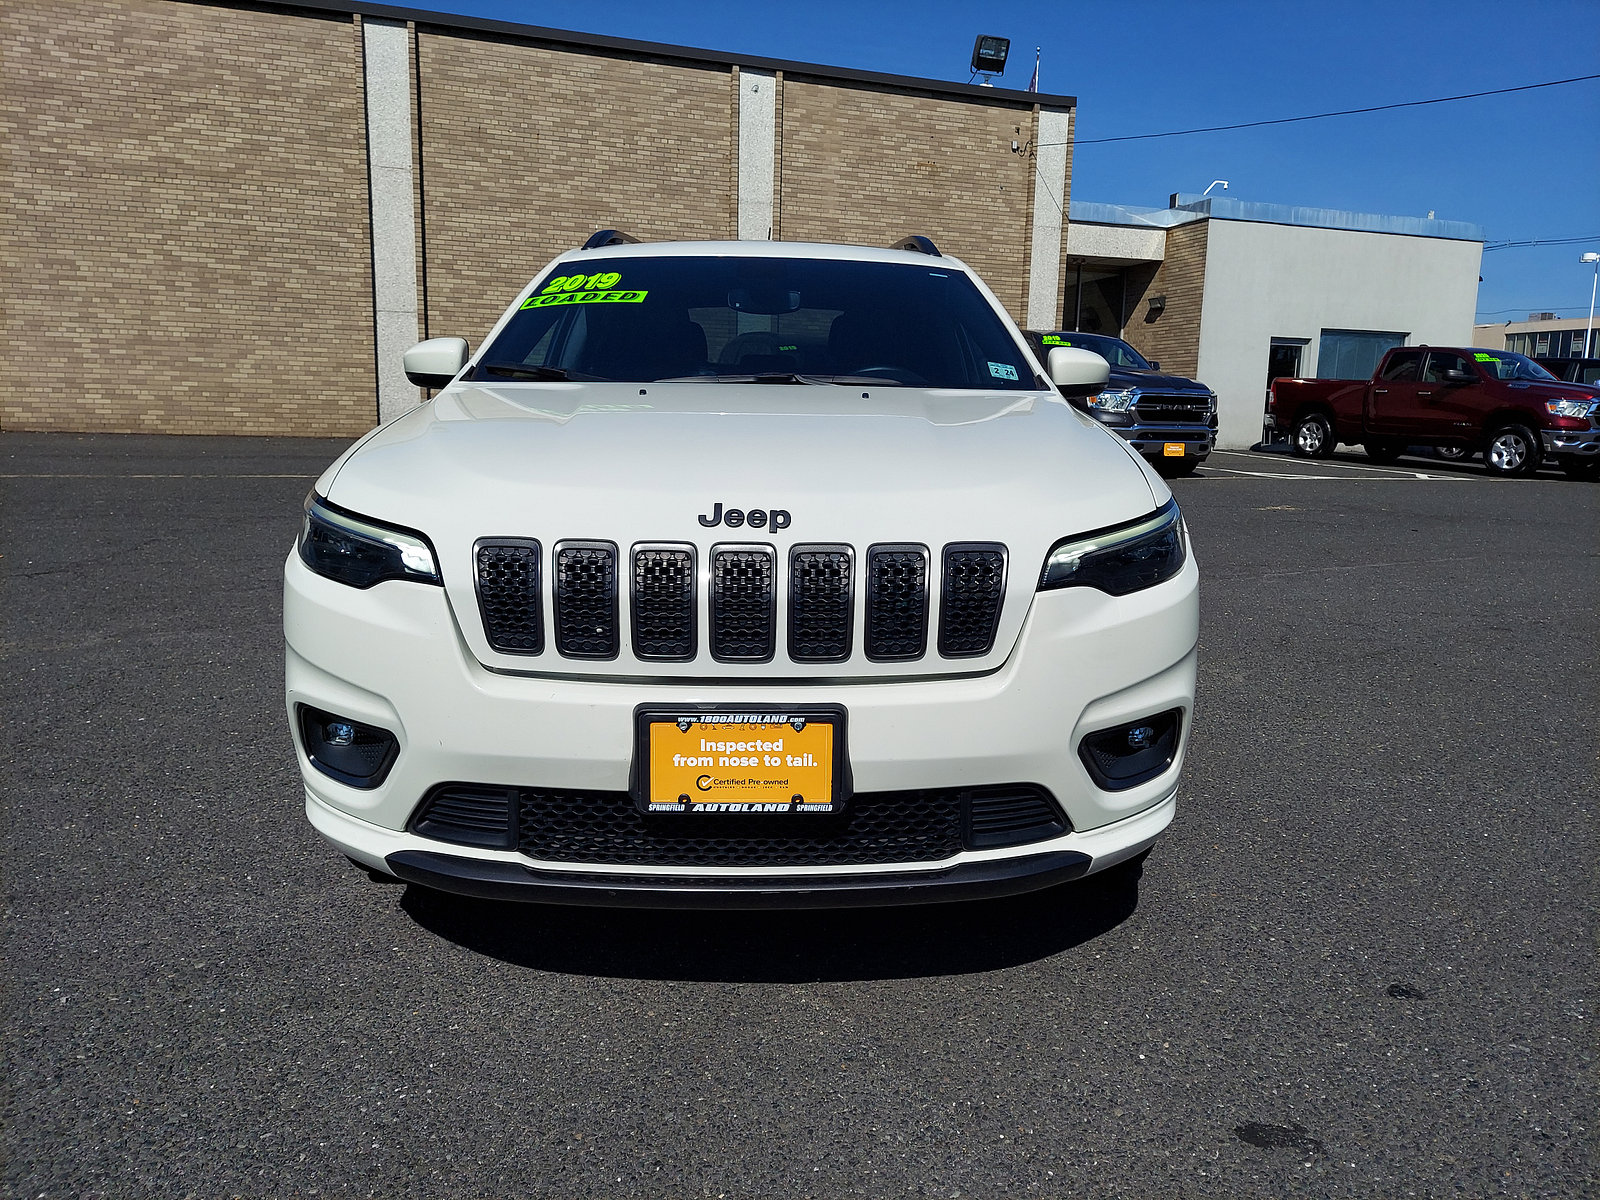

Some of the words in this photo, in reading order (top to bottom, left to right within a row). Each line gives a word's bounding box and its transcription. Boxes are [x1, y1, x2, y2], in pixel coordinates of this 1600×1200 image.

[541, 272, 622, 294] 2019
[523, 291, 641, 308] LOADED
[698, 502, 792, 534] Jeep
[677, 714, 805, 724] www.1800AUTOLAND.com
[700, 738, 783, 755] Inspected
[673, 754, 713, 767] from
[719, 756, 759, 767] nose
[764, 755, 781, 767] to
[786, 754, 818, 767] tail.
[648, 803, 686, 812] SPRINGFIELD
[692, 803, 791, 812] AUTOLAND
[796, 803, 833, 812] SPRINGFIELD
